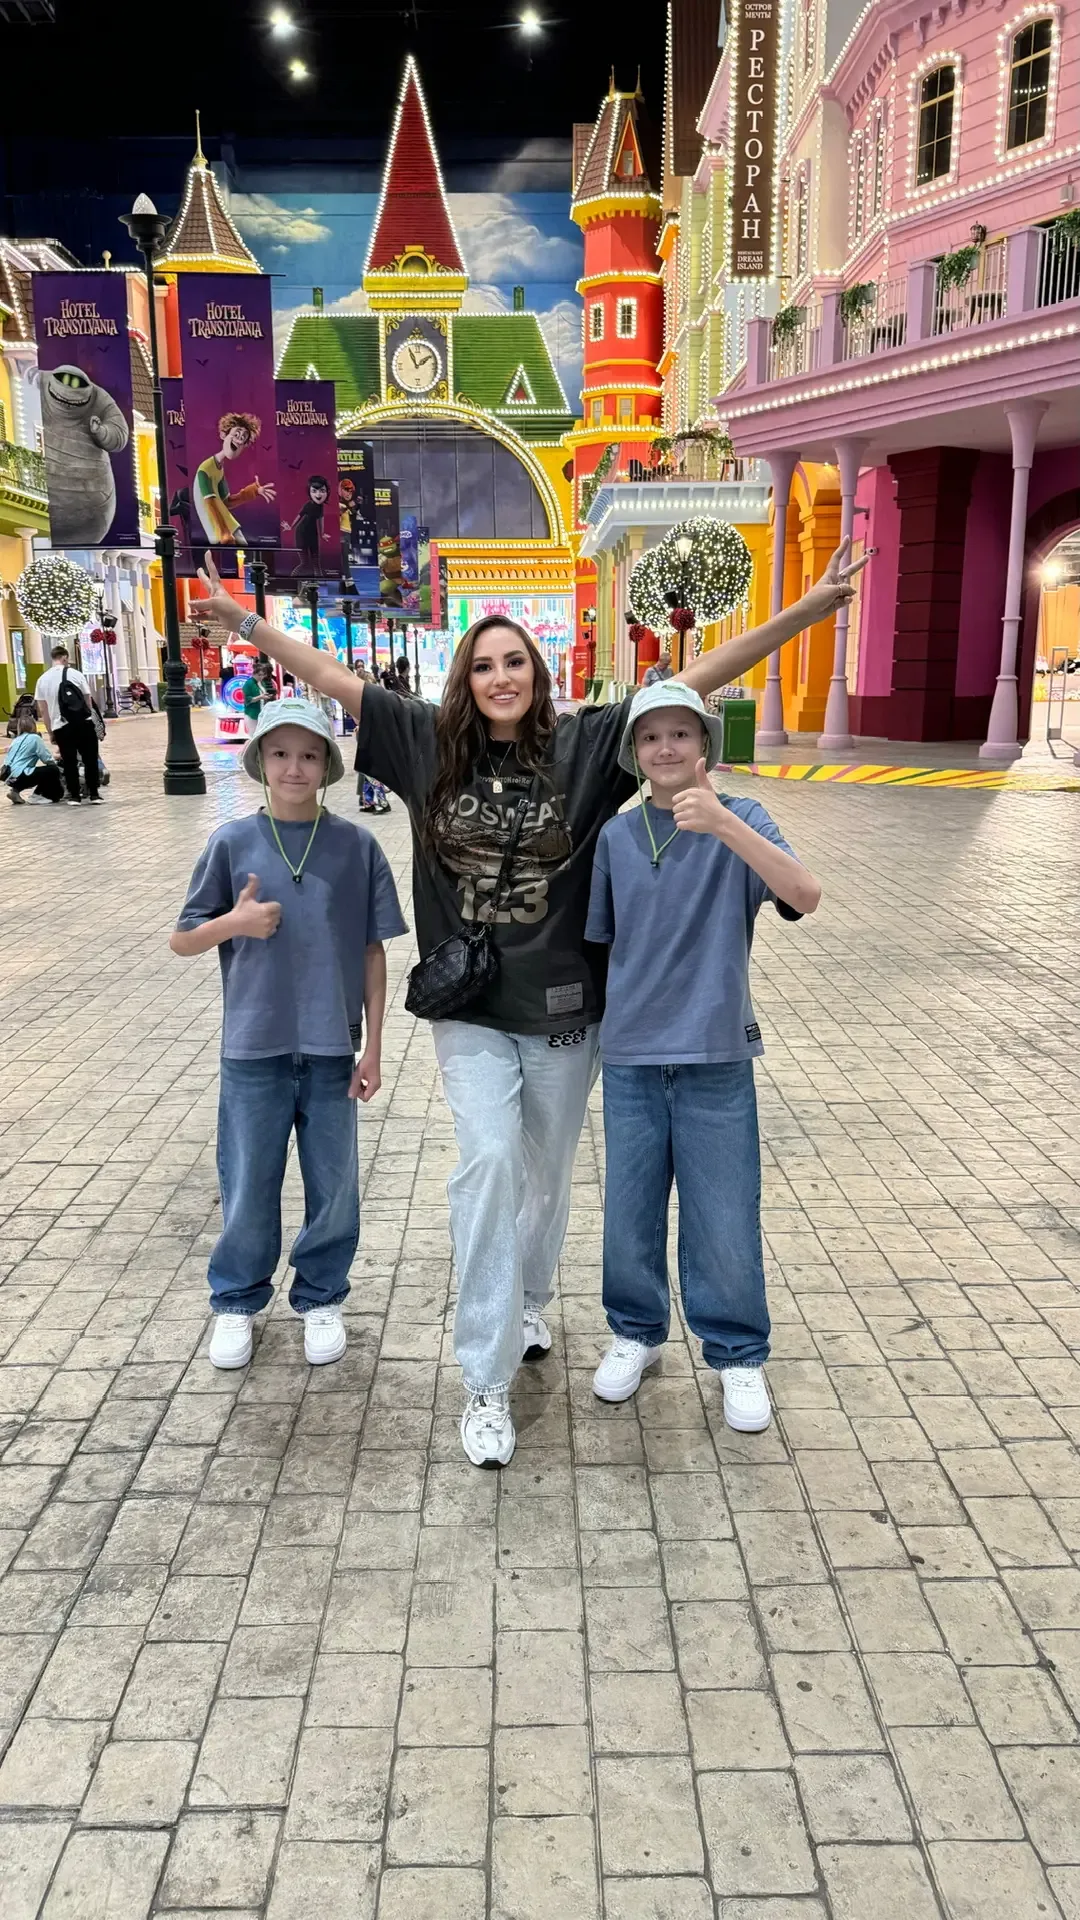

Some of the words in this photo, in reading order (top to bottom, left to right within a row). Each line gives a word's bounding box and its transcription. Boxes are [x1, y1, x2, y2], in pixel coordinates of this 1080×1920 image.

[744, 3, 772, 11] ОСТРОВ
[744, 11, 771, 19] МЕЧТЫ
[741, 29, 766, 240] РЕСТОРАН
[737, 255, 763, 263] DREAM
[60, 299, 100, 319] HOTEL
[206, 301, 245, 320] HOTEL
[43, 316, 118, 337] TRANSYLVANIA
[188, 318, 264, 339] TRANSYLVANIA
[286, 399, 316, 413] HOTEL
[275, 410, 329, 427] TRANSYLVANIA
[480, 793, 567, 829] SWEAT
[456, 875, 549, 924] 123
